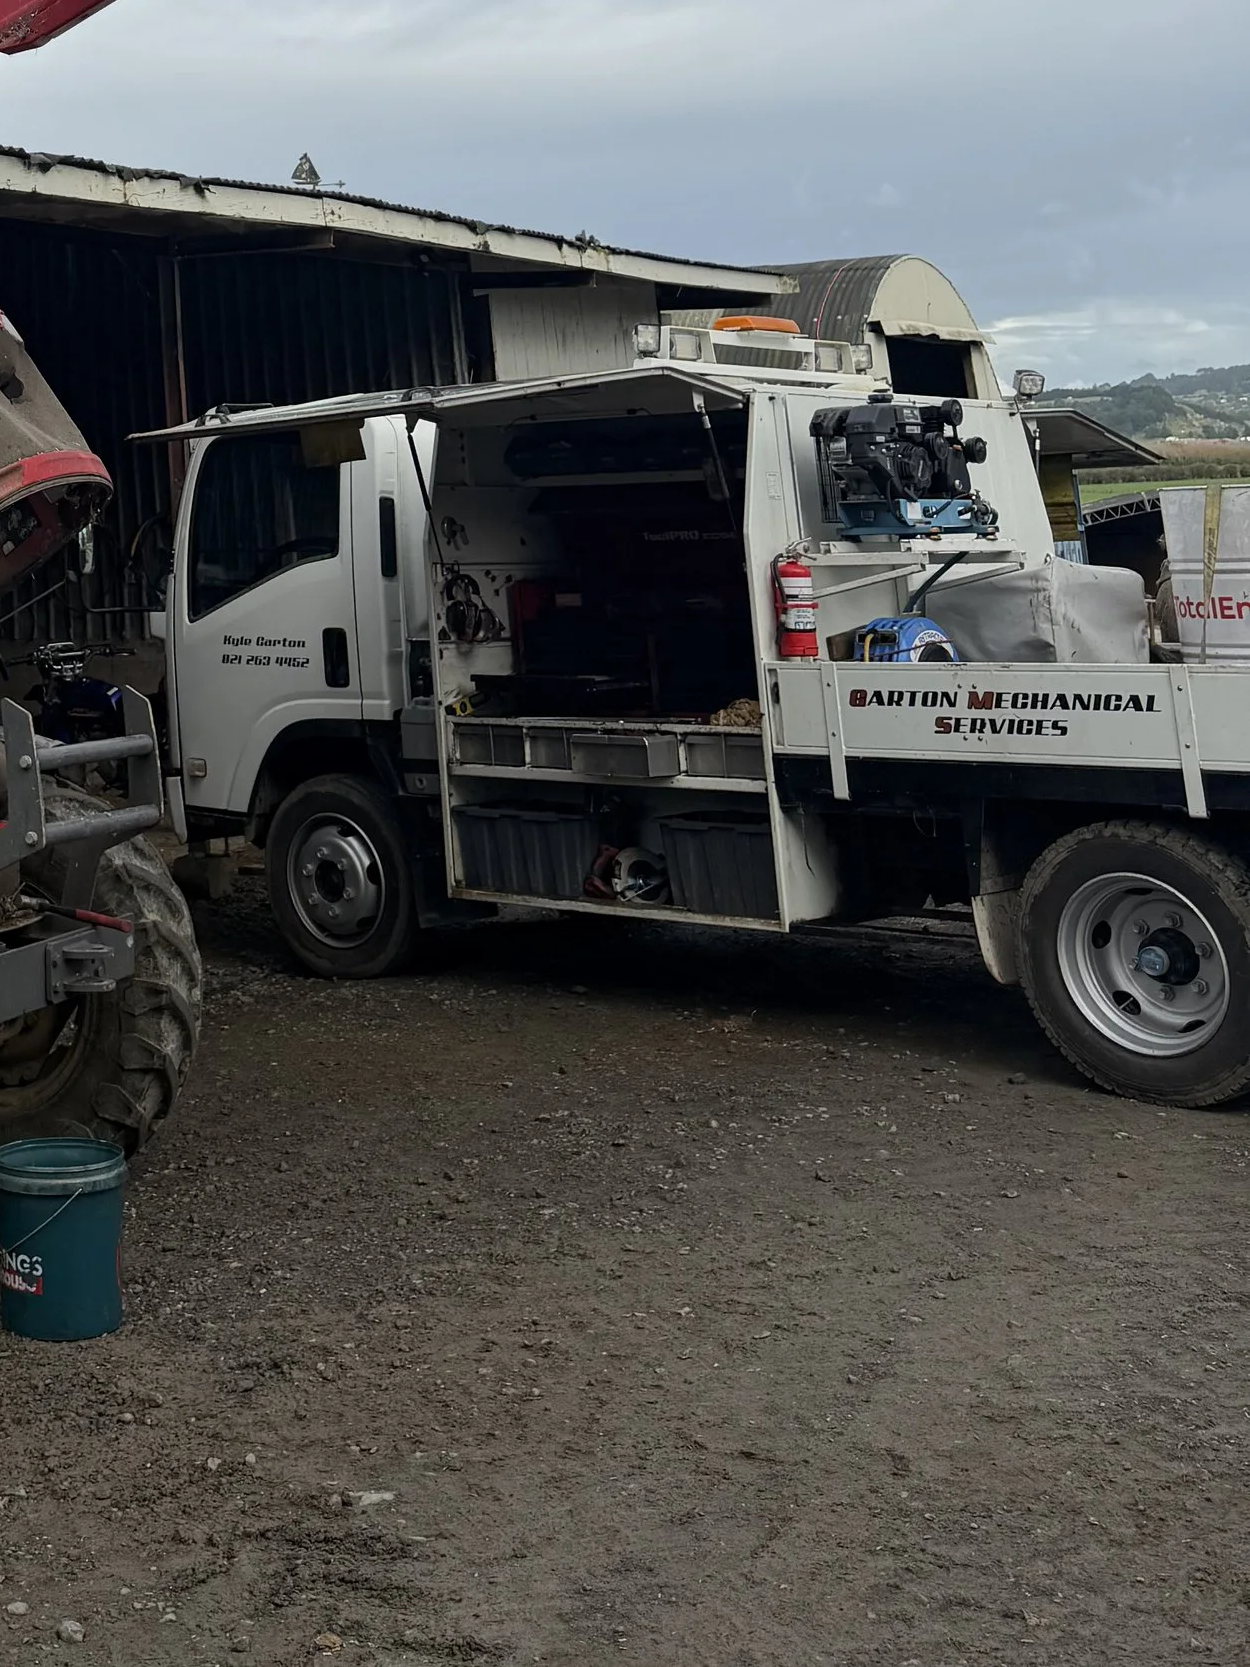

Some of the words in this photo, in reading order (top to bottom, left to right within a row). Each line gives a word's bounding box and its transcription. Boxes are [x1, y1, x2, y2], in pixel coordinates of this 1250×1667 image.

[223, 635, 252, 647] Kyle
[256, 636, 306, 648] Garton
[221, 654, 242, 665] 021
[246, 654, 271, 666] 263
[275, 656, 310, 668] 4452
[849, 689, 958, 708] GARTON
[967, 691, 1162, 713] MECHANICAL
[934, 716, 1068, 737] SERVICES
